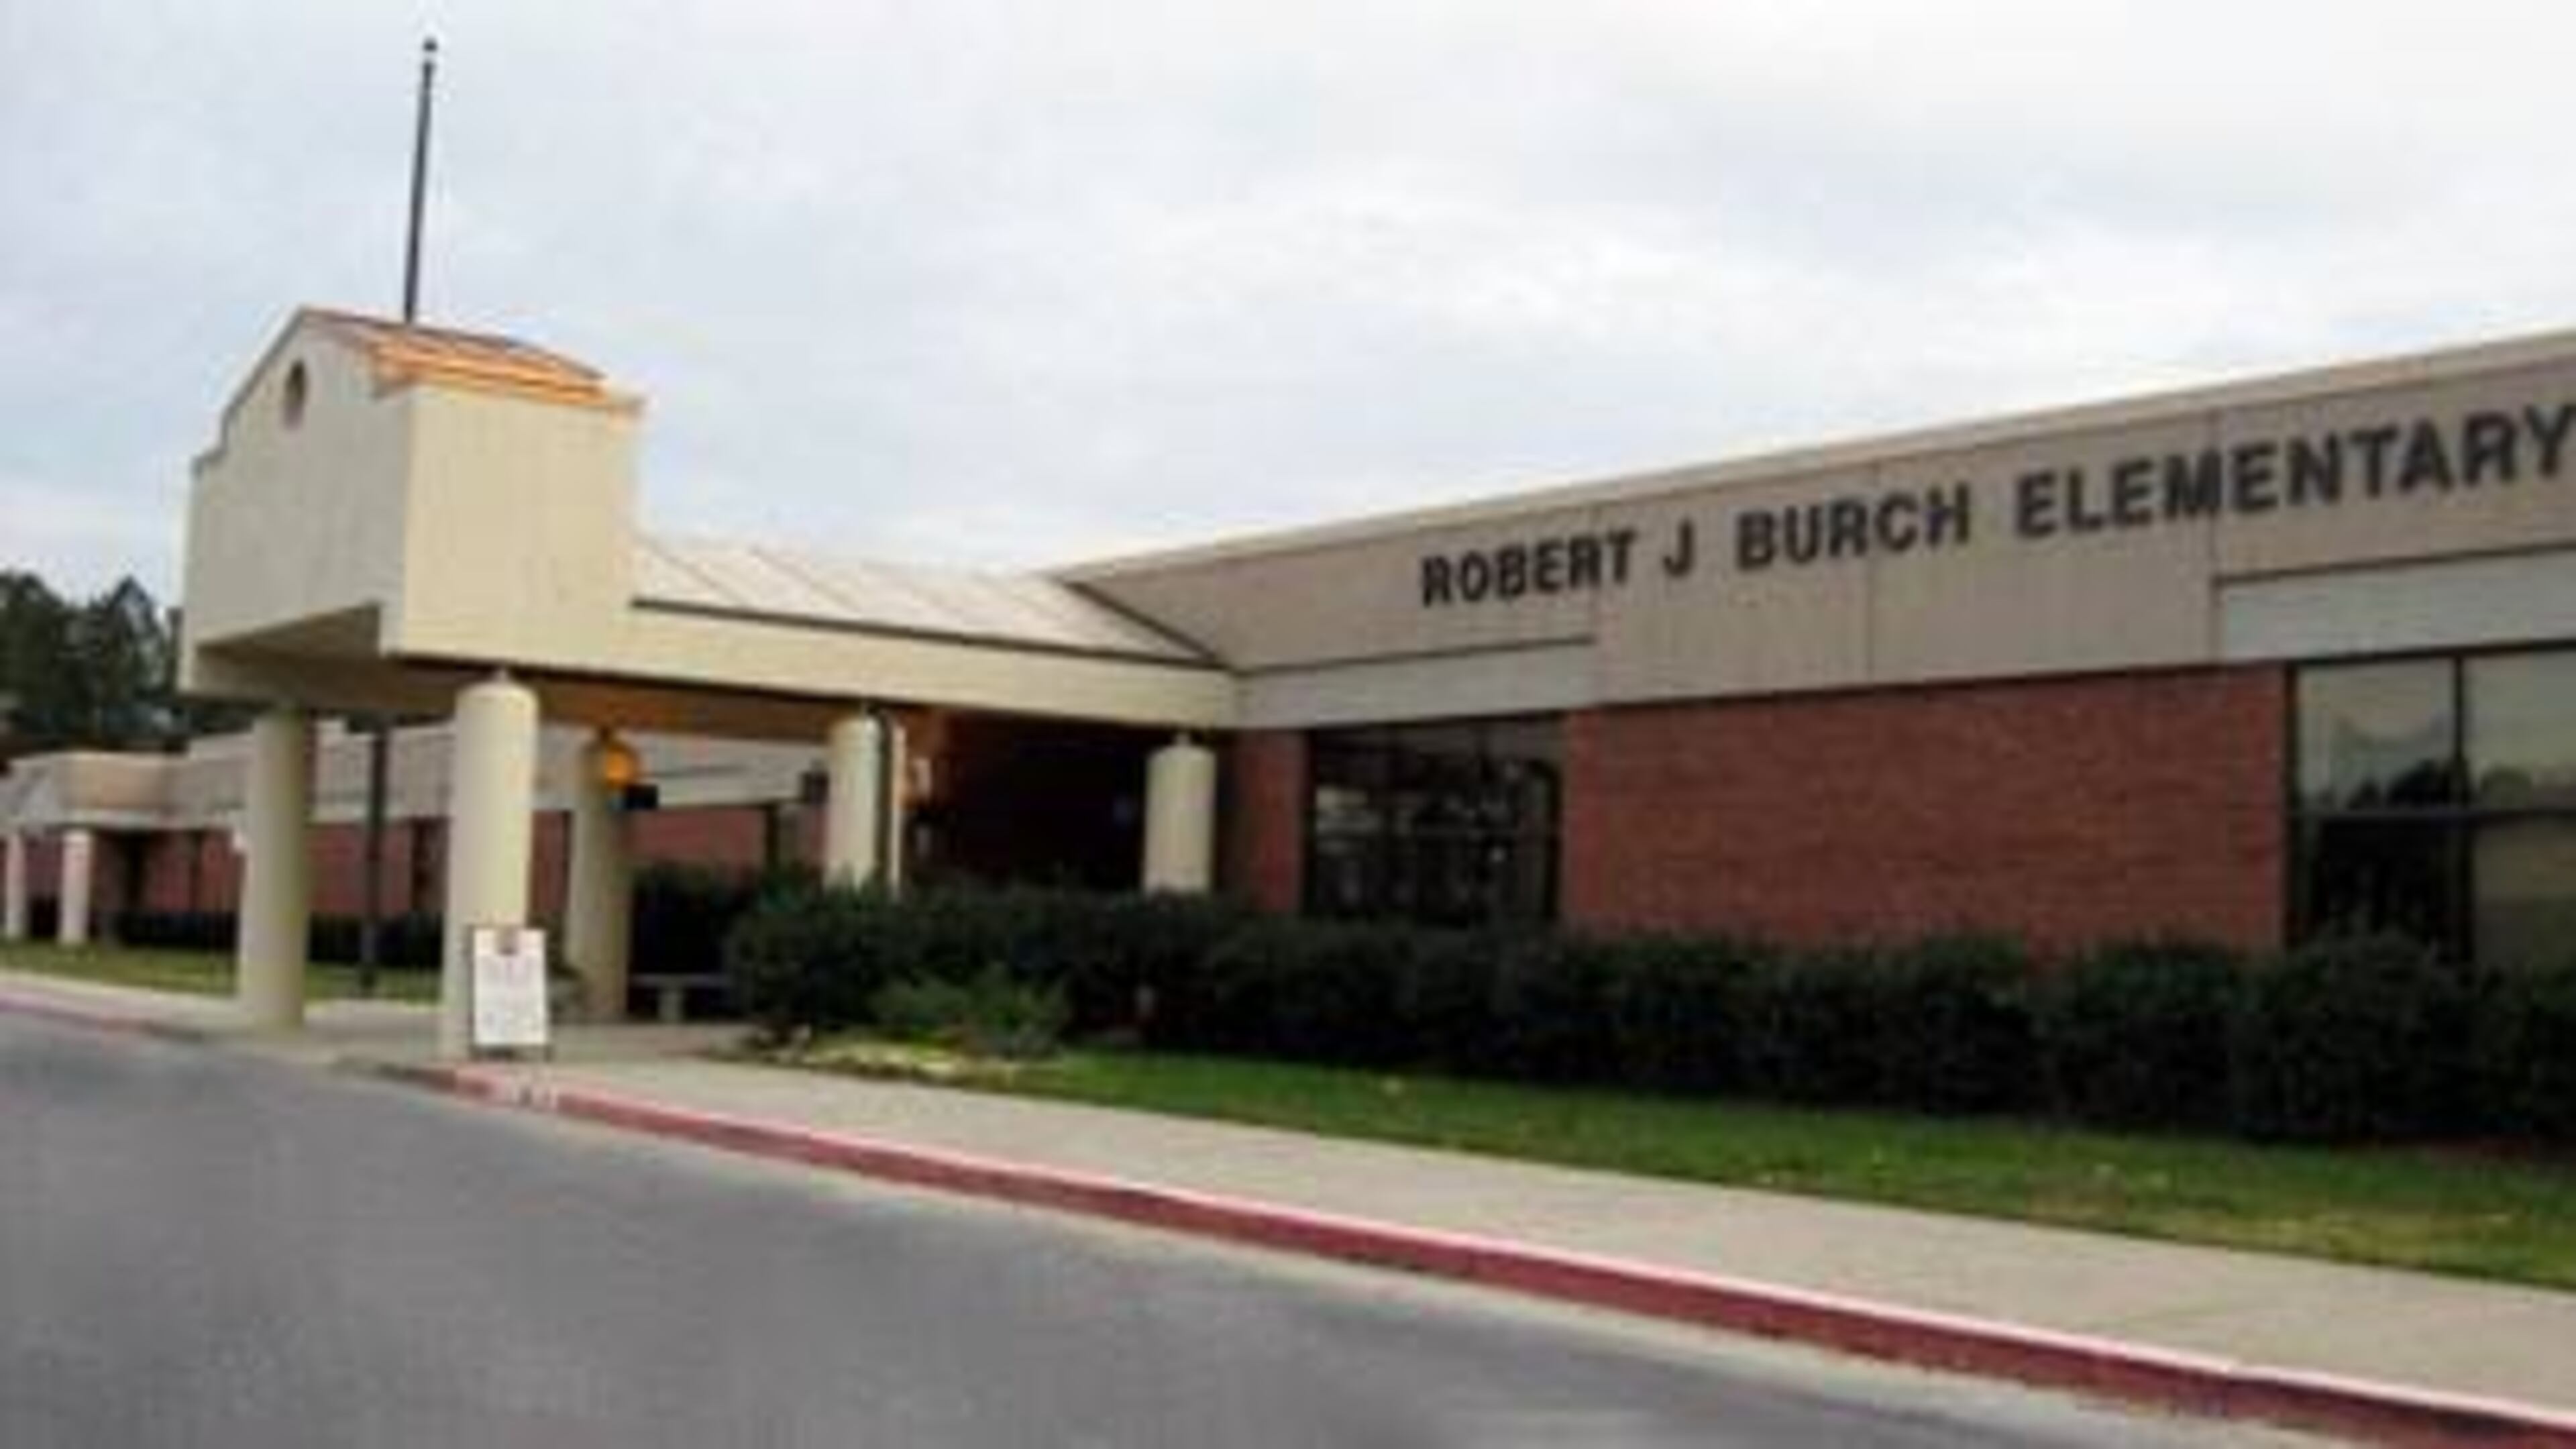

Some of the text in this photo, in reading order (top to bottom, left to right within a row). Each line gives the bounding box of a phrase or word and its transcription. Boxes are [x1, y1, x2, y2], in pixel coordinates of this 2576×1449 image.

[1420, 402, 2576, 607] ROBERT J BURCH ELEMENTARY
